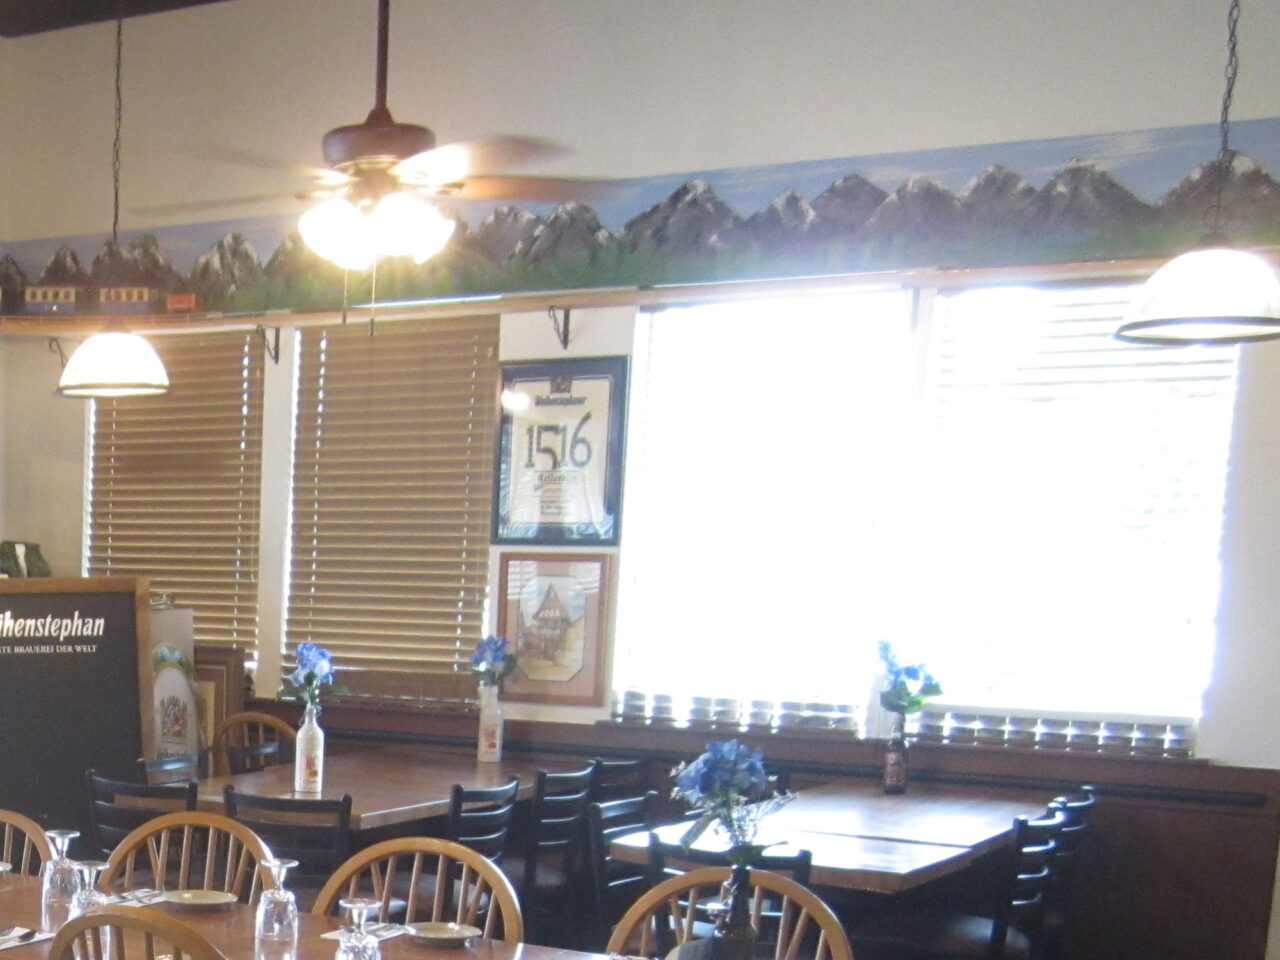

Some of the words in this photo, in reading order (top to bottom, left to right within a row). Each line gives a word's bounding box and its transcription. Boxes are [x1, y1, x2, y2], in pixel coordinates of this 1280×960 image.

[525, 410, 593, 470] 1516
[13, 644, 55, 654] BRAUEREI
[56, 644, 73, 653] DER
[74, 644, 98, 653] WELT
